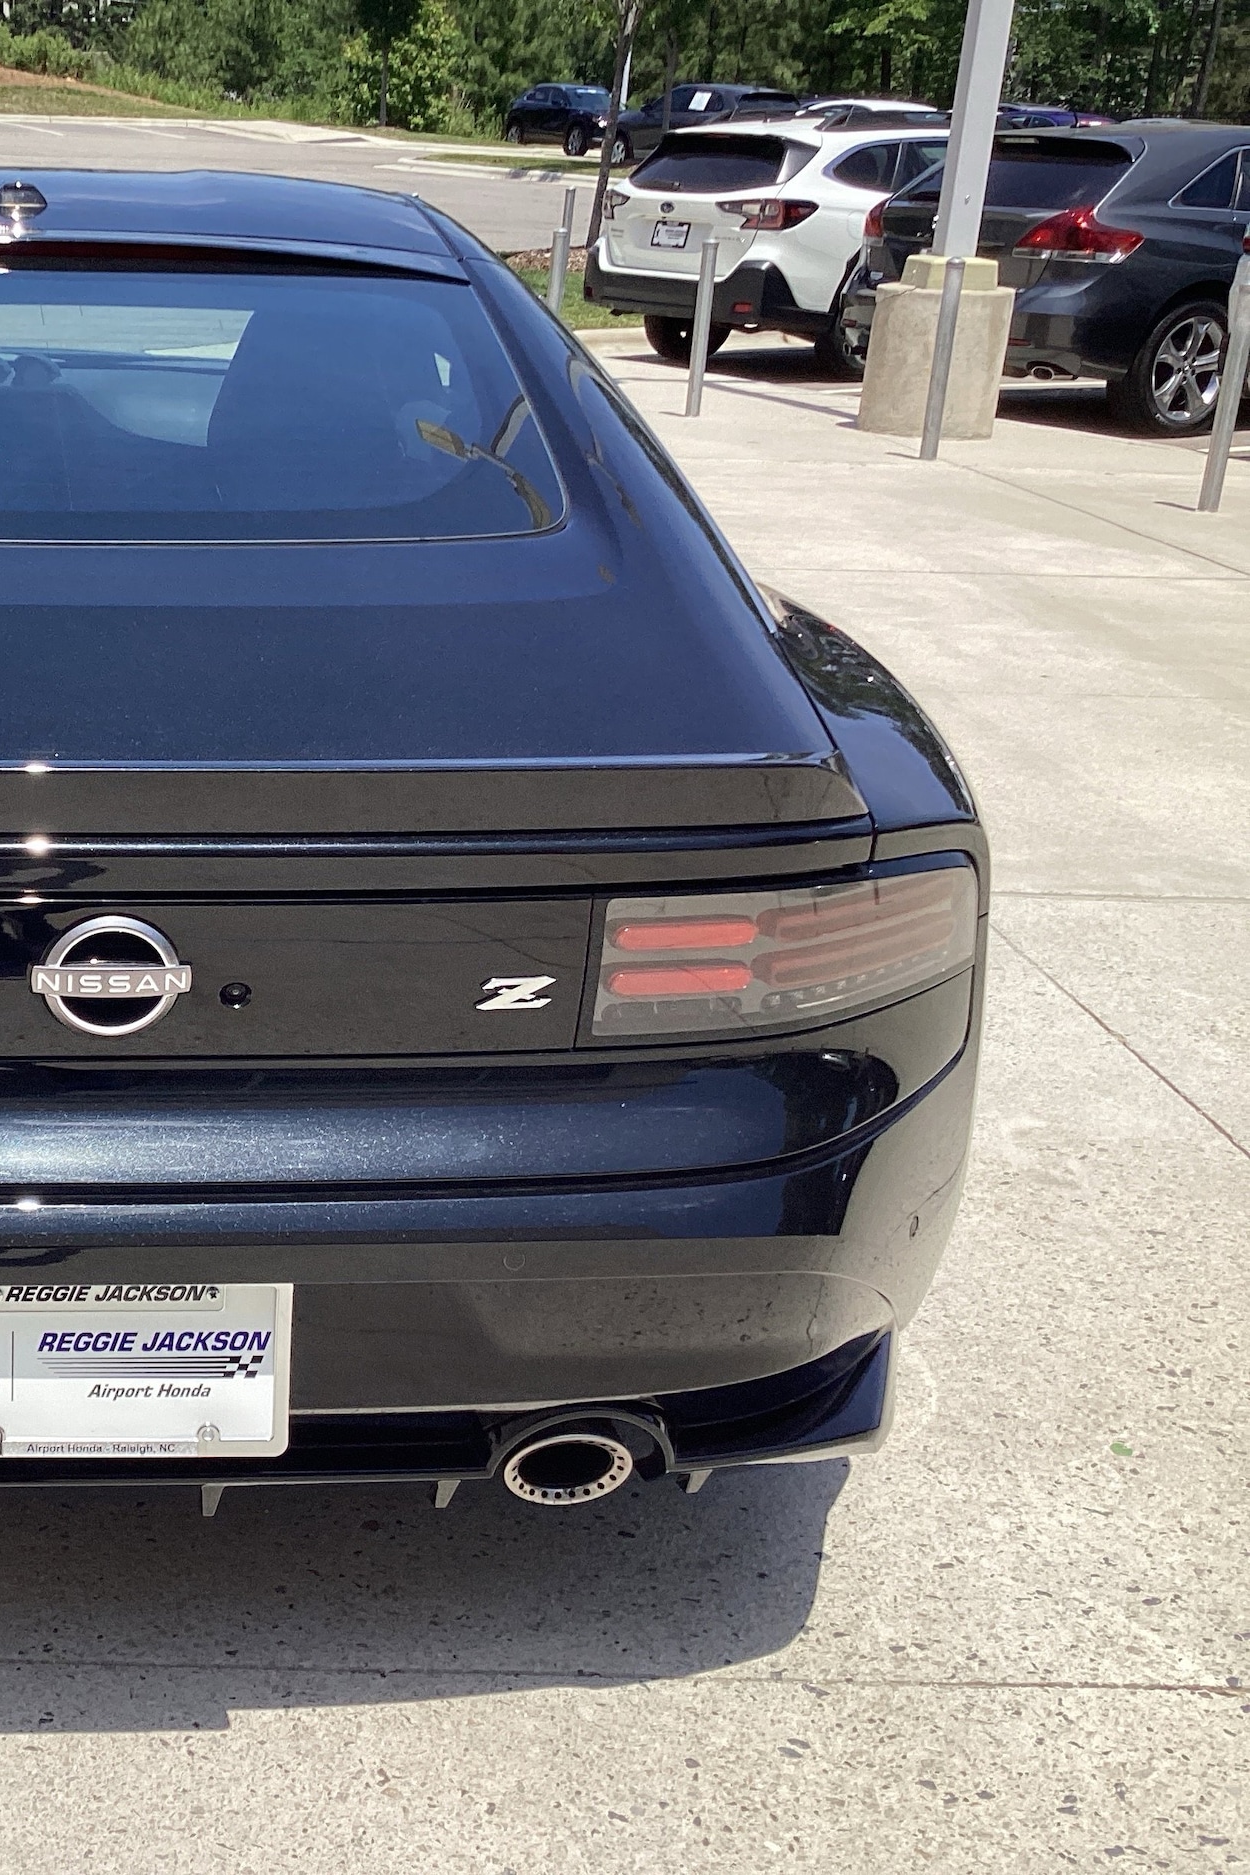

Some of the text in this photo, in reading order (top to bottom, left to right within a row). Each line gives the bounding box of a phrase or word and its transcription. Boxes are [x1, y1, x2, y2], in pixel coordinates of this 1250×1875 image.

[36, 971, 187, 994] NISSAN
[474, 975, 557, 1011] Z
[5, 1285, 207, 1302] REGGIE JACKSON
[36, 1331, 272, 1352] REGGIE JACKSON
[87, 1383, 212, 1401] Airport Honda
[26, 1443, 65, 1456] Airport
[67, 1443, 103, 1453] Honda
[159, 1443, 176, 1453] NC
